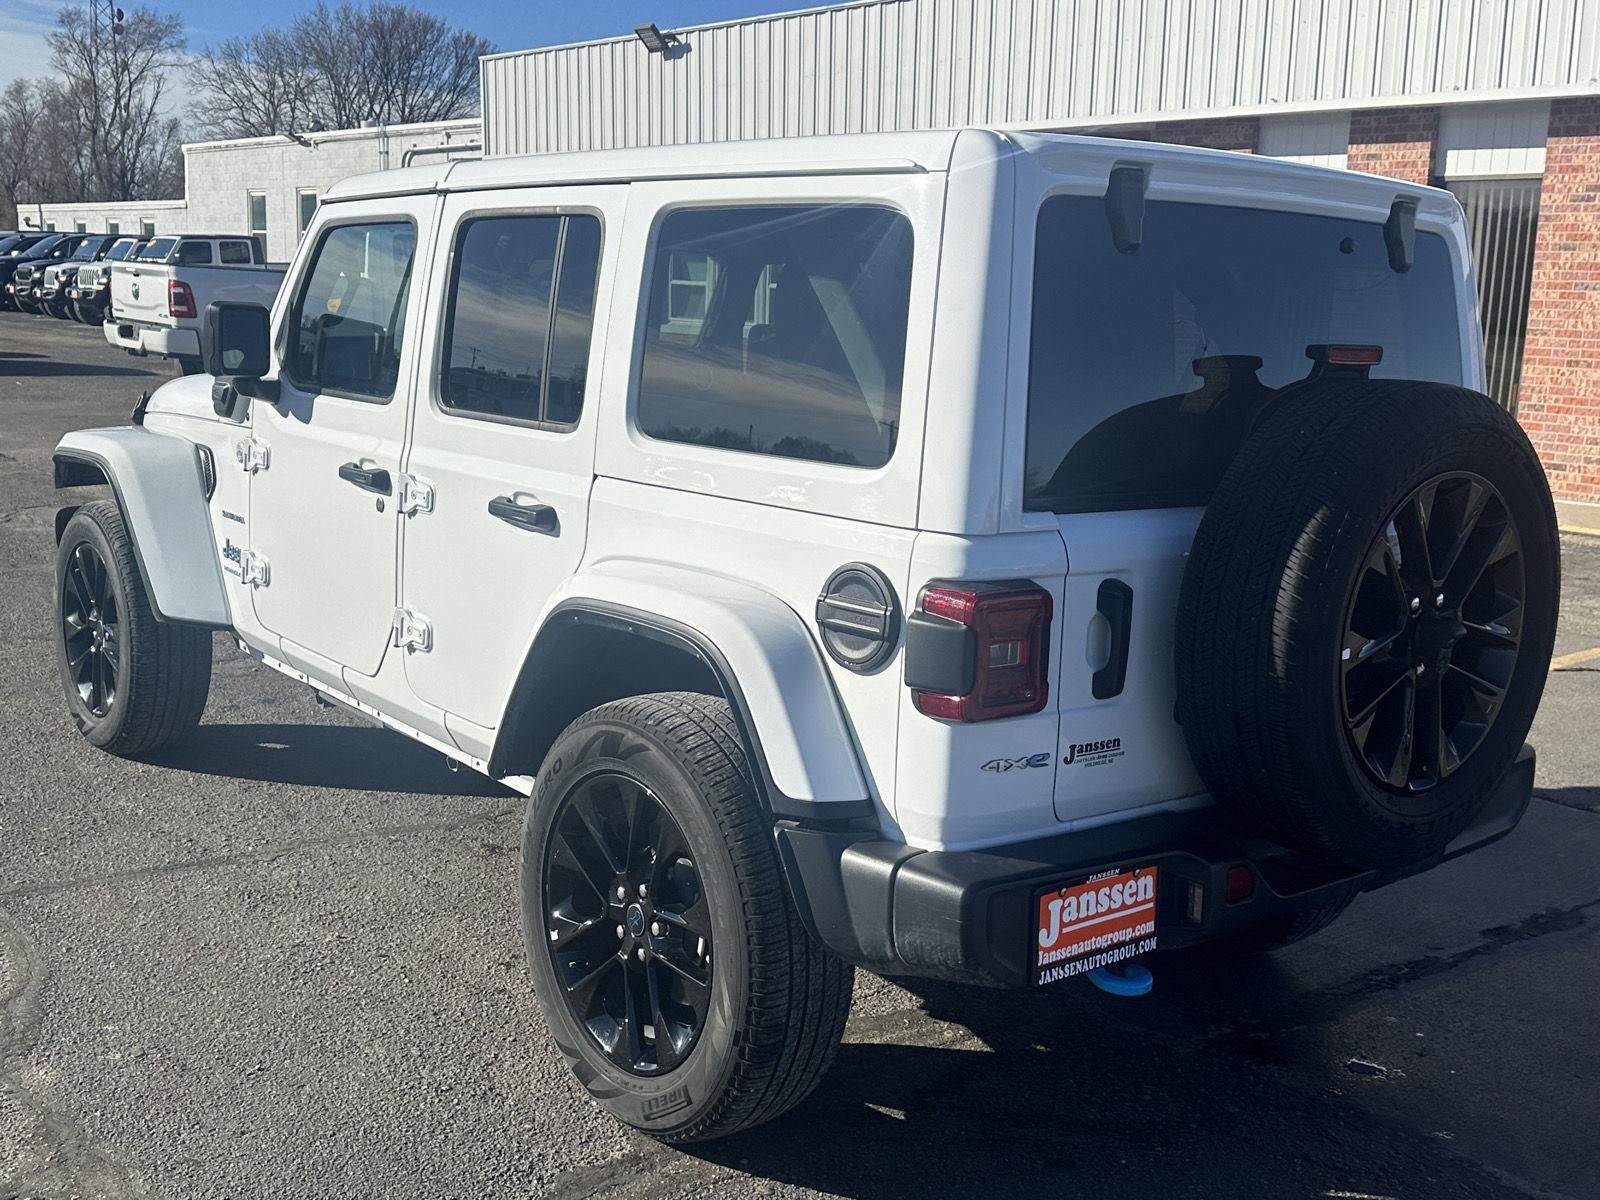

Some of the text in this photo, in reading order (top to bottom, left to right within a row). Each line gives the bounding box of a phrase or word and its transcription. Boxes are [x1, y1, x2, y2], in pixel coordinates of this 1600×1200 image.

[1063, 737, 1121, 765] Janssen
[1086, 868, 1121, 884] JANSSEN
[1038, 874, 1154, 948] Janssen
[1038, 919, 1155, 967] Janssenautogroup.com
[1038, 936, 1158, 986] JANSSENAUTOGROUP.COM
